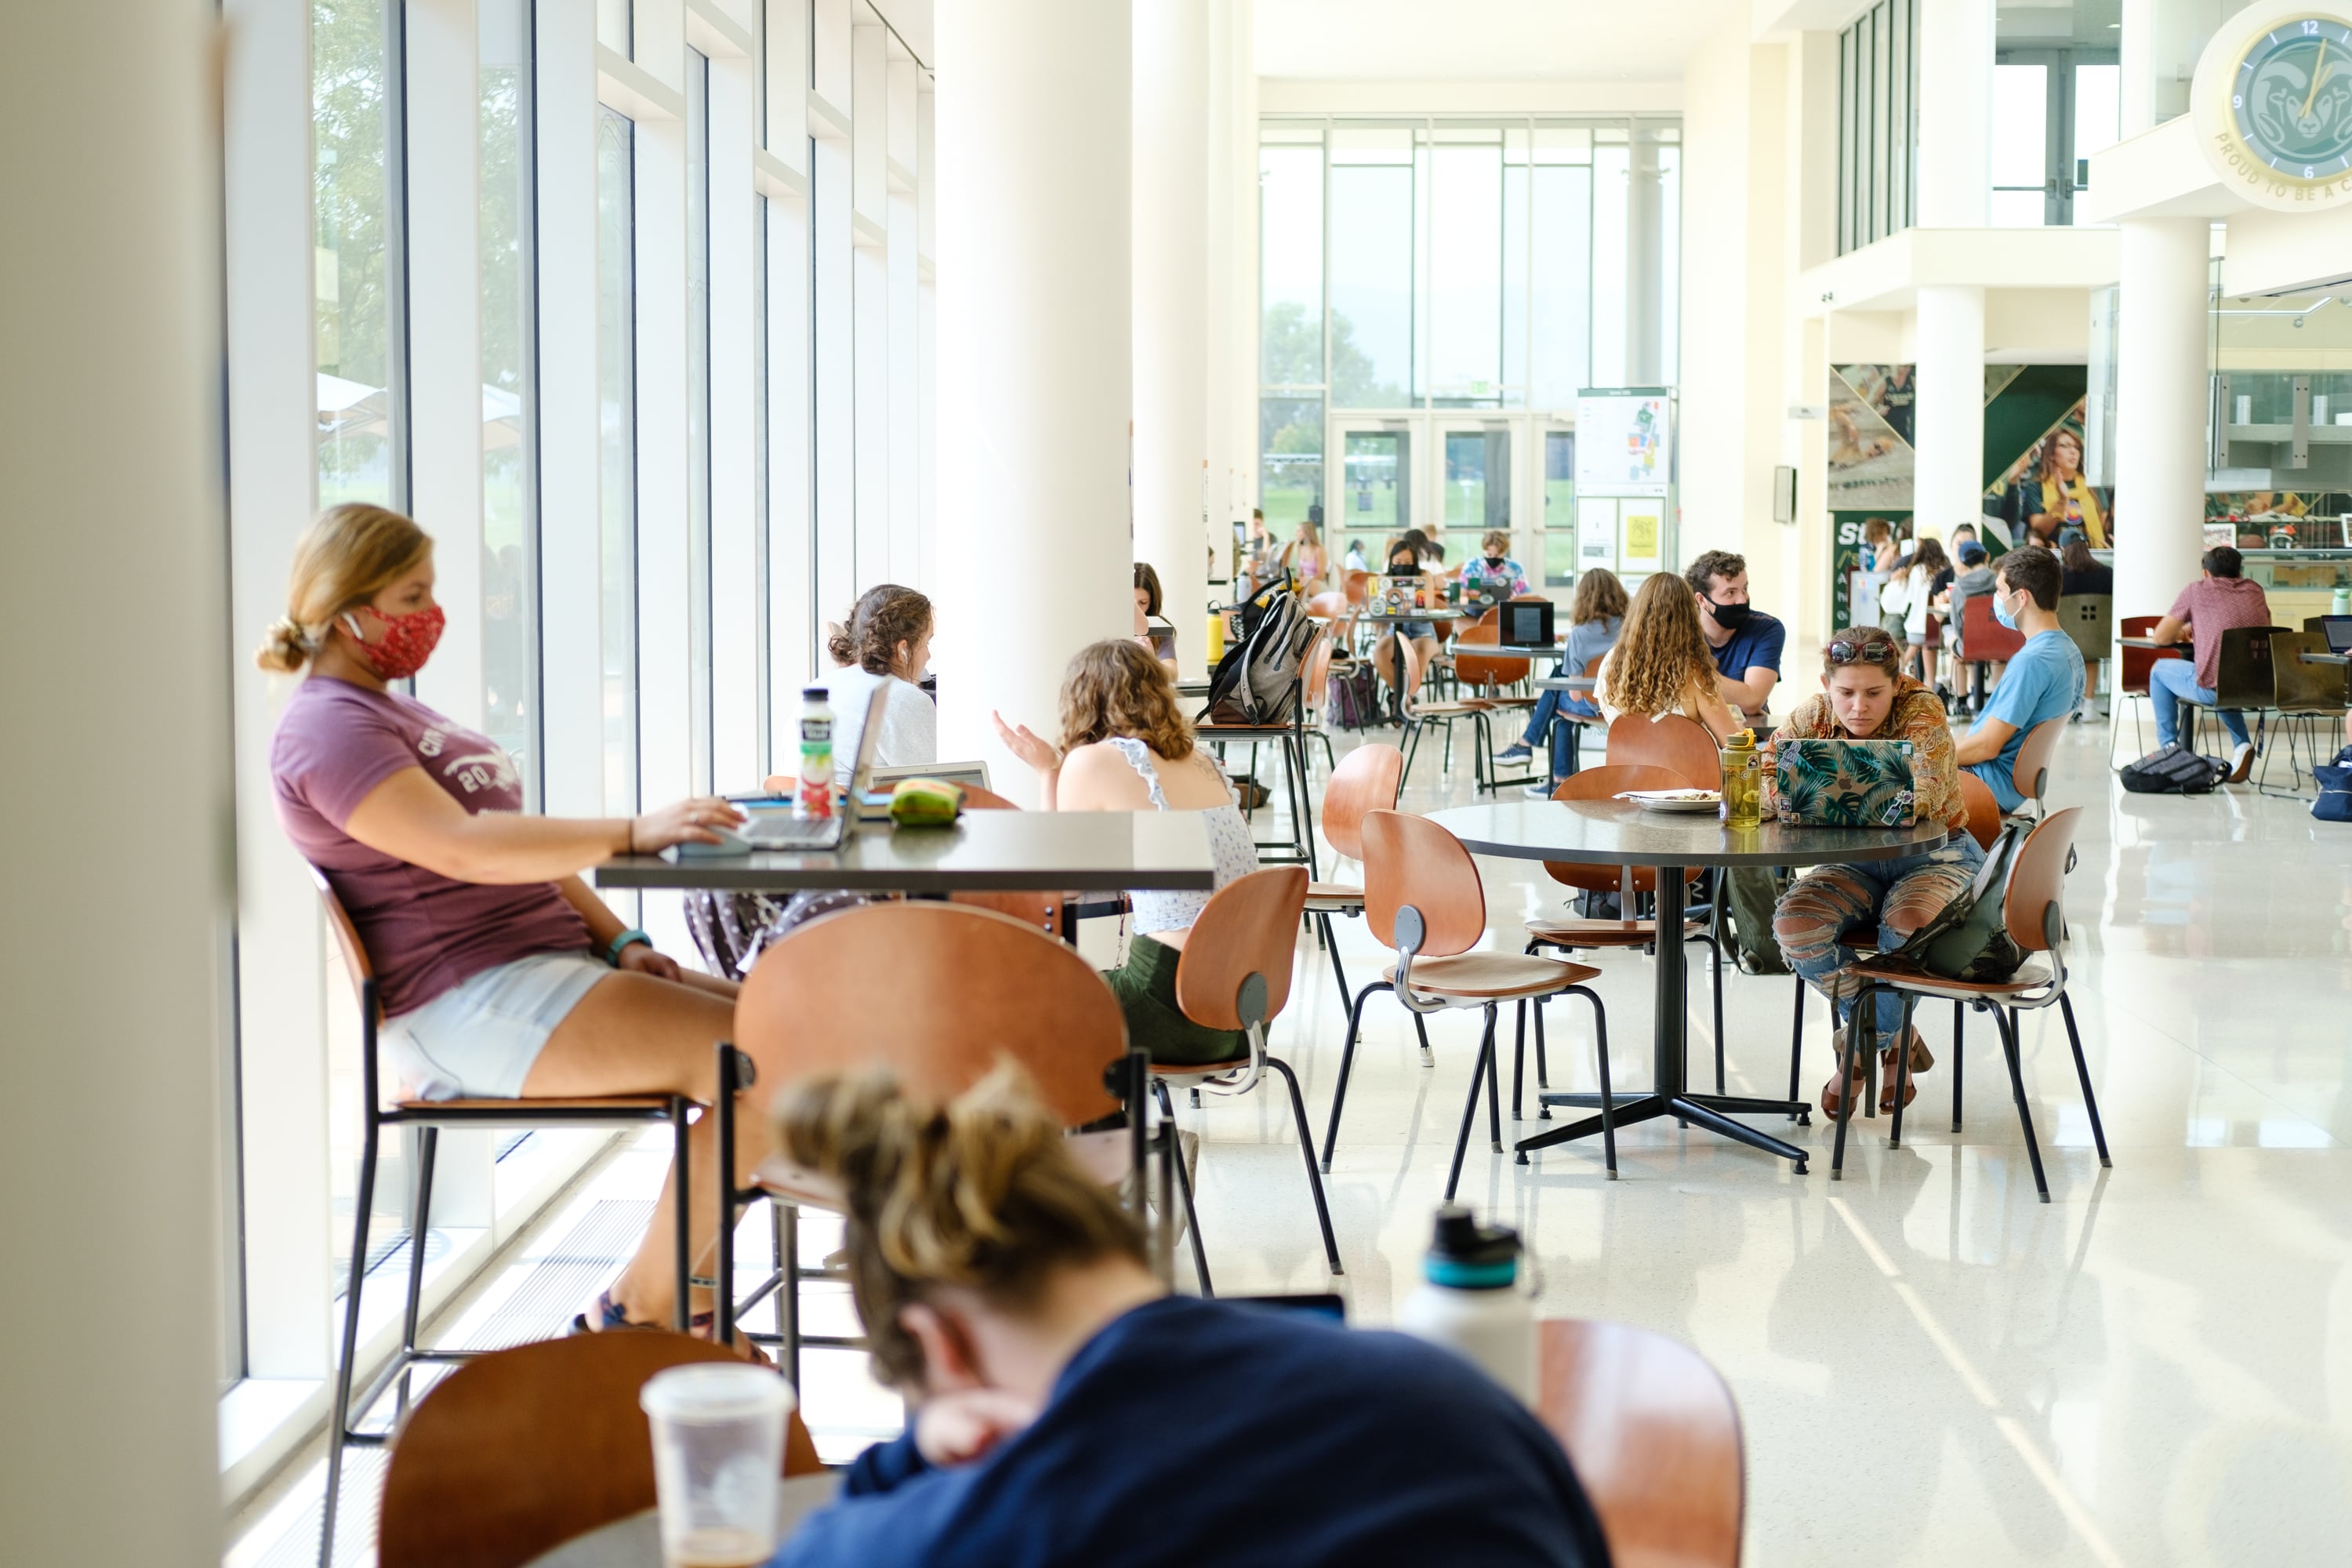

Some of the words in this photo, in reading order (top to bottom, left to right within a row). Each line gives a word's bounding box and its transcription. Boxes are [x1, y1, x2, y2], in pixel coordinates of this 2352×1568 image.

[2301, 20, 2318, 34] 12
[2232, 95, 2242, 108] 9
[2215, 132, 2259, 184] PROUD
[2266, 181, 2286, 198] TO
[2296, 187, 2315, 201] BE
[2325, 186, 2335, 198] A
[2304, 166, 2314, 179] 6
